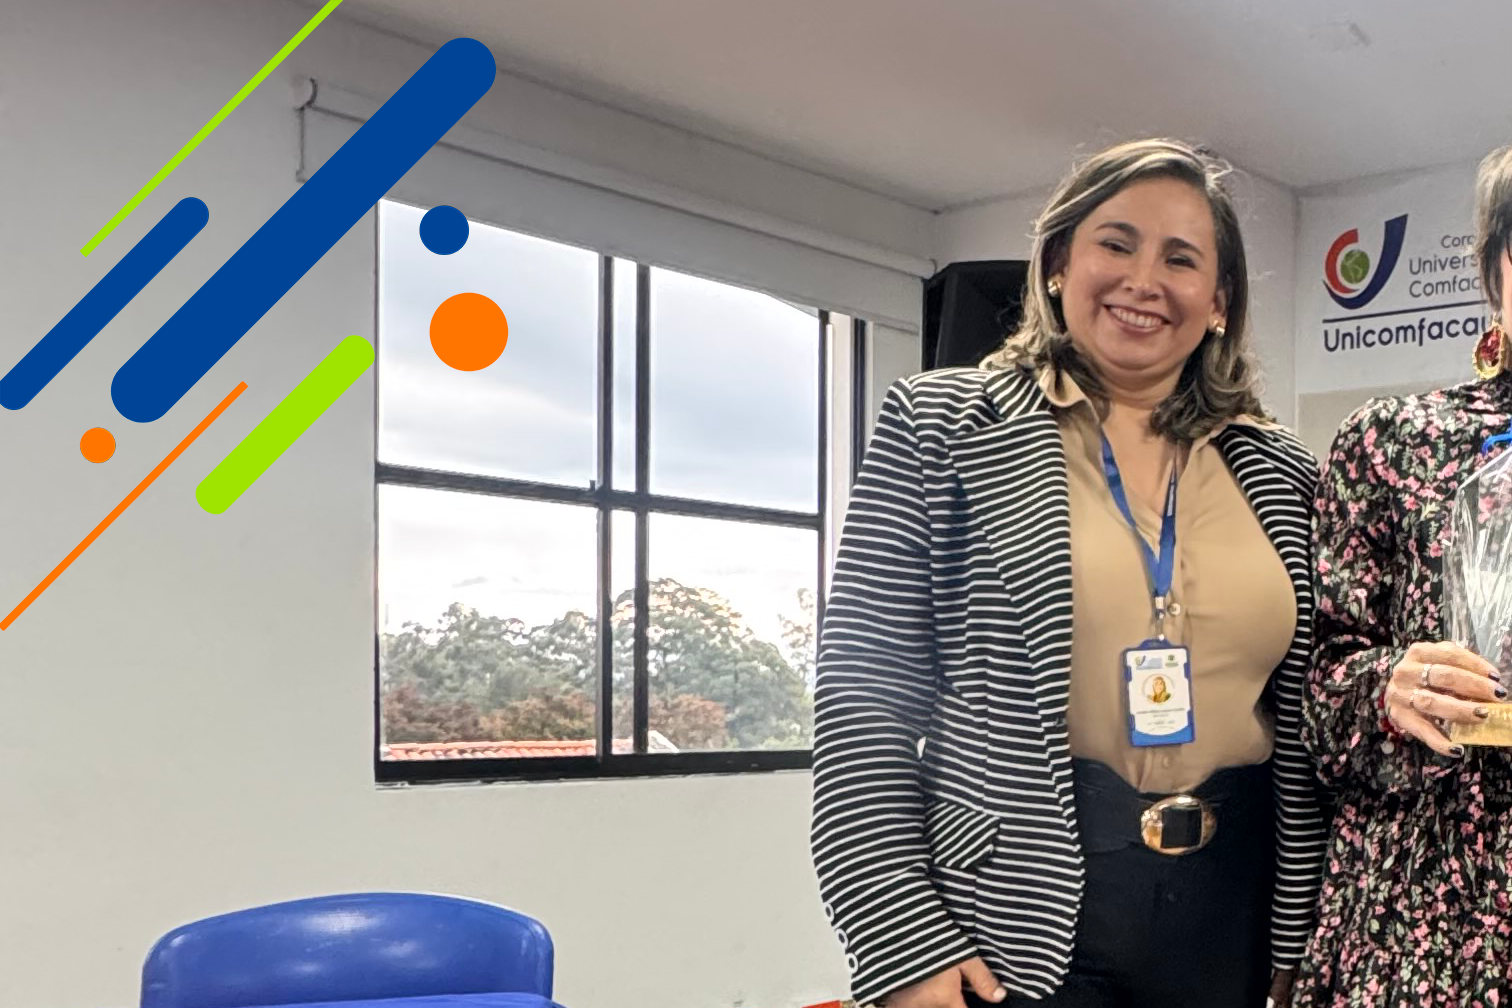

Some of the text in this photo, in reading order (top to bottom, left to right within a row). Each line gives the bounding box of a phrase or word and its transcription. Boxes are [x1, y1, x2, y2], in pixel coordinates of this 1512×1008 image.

[1409, 253, 1479, 275] Univers
[1409, 275, 1482, 298] Comfac
[1323, 316, 1487, 352] Unicomfaca
